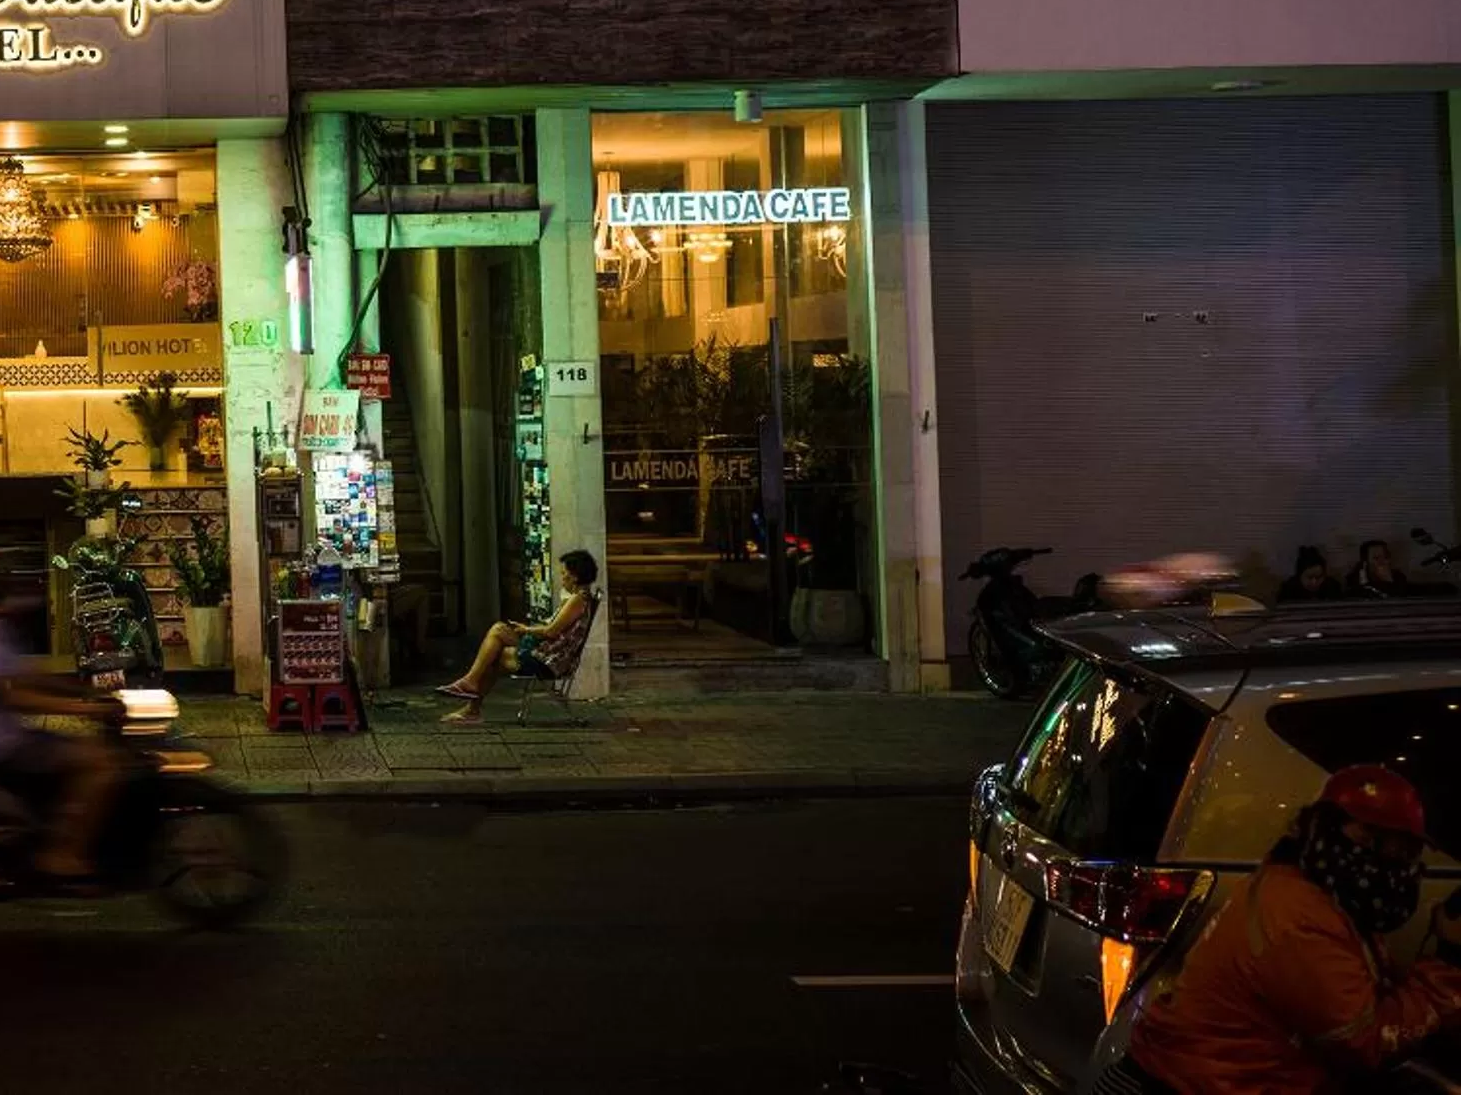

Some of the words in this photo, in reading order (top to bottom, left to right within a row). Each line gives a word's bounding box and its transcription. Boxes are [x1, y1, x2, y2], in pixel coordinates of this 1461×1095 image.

[610, 191, 762, 223] LAMENDA
[769, 190, 850, 220] CAFE
[229, 318, 277, 347] 120
[556, 368, 588, 382] 118
[610, 458, 699, 482] LAMENDA
